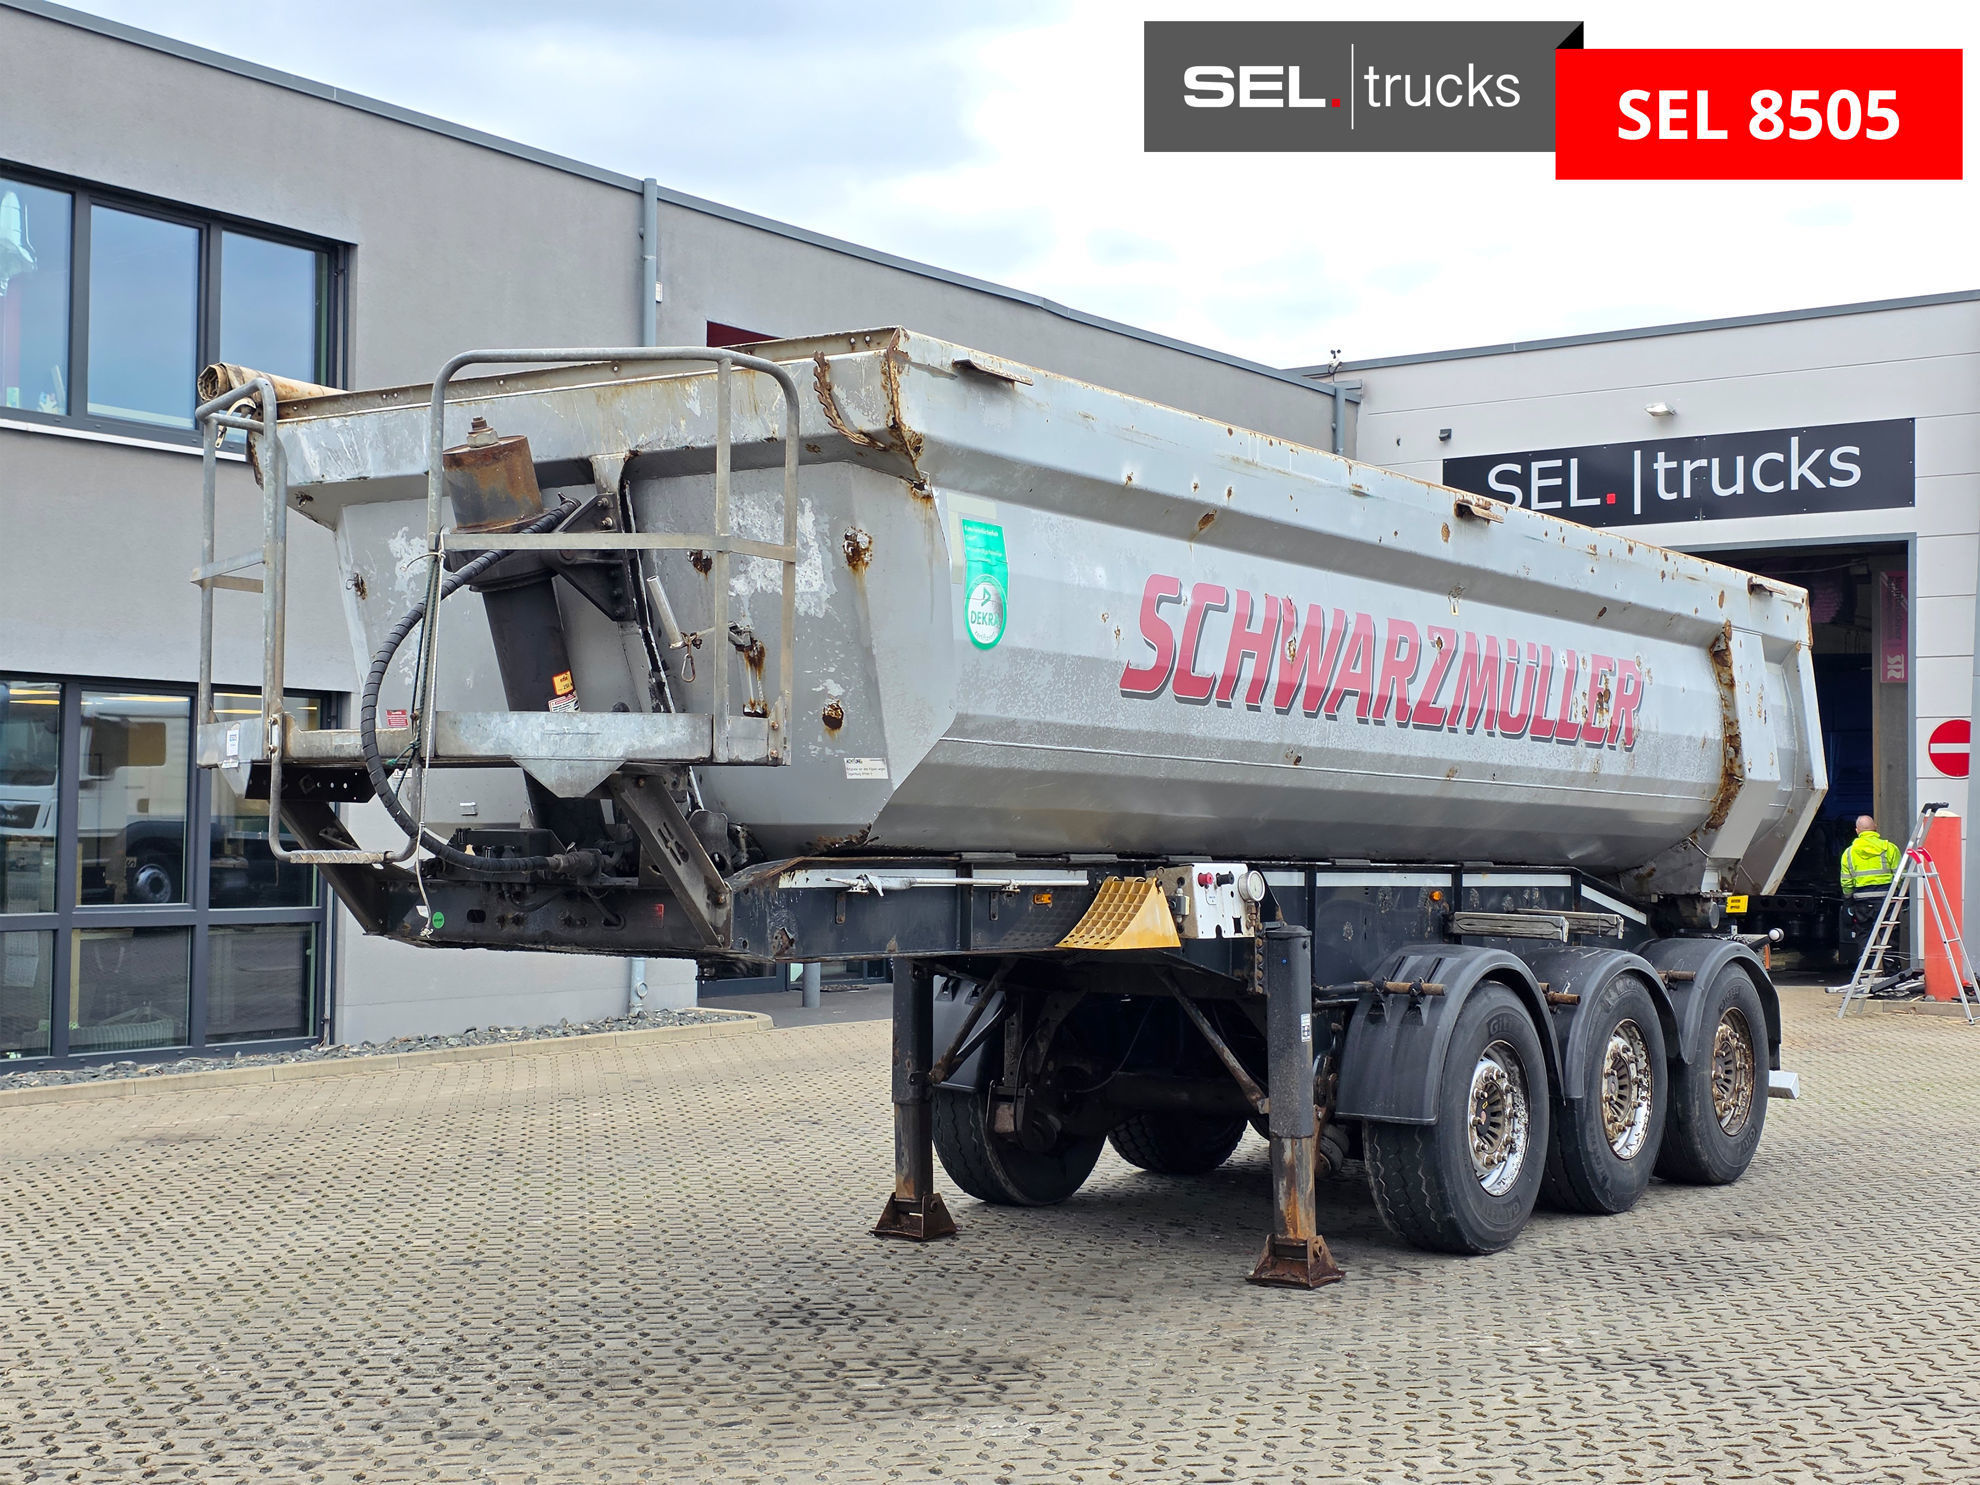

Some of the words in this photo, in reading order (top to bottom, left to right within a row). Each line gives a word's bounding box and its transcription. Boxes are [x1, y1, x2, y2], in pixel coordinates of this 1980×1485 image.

[1653, 436, 1863, 501] trucks
[970, 610, 1001, 629] DEKRA
[1119, 573, 1645, 751] SCHWARZMÜLLER
